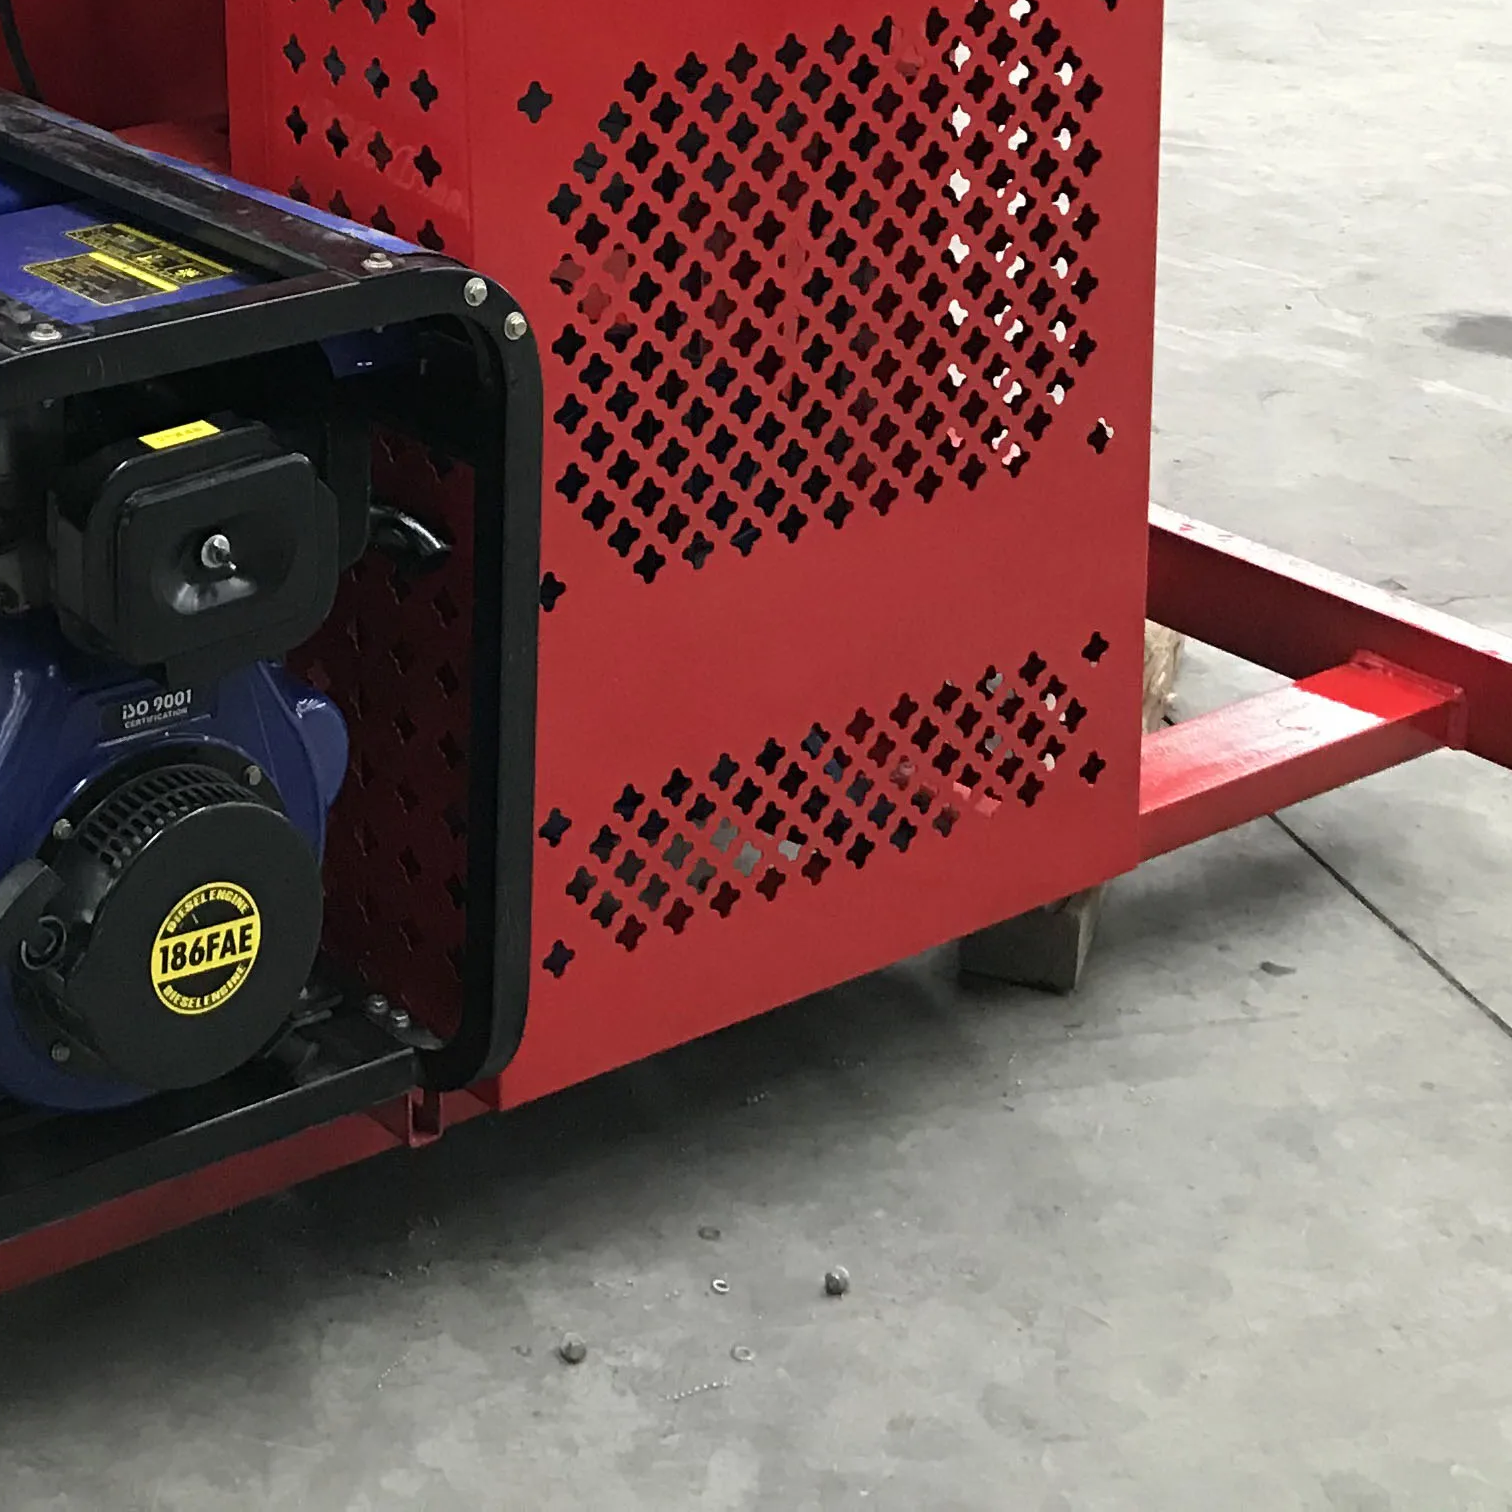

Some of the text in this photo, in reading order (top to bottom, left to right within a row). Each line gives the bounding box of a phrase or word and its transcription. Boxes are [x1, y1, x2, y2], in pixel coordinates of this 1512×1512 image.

[153, 689, 192, 712] 9001
[124, 707, 188, 729] CERTIFICATION
[166, 888, 250, 934] DIESEL ENGINE
[159, 922, 254, 975] 186FAE
